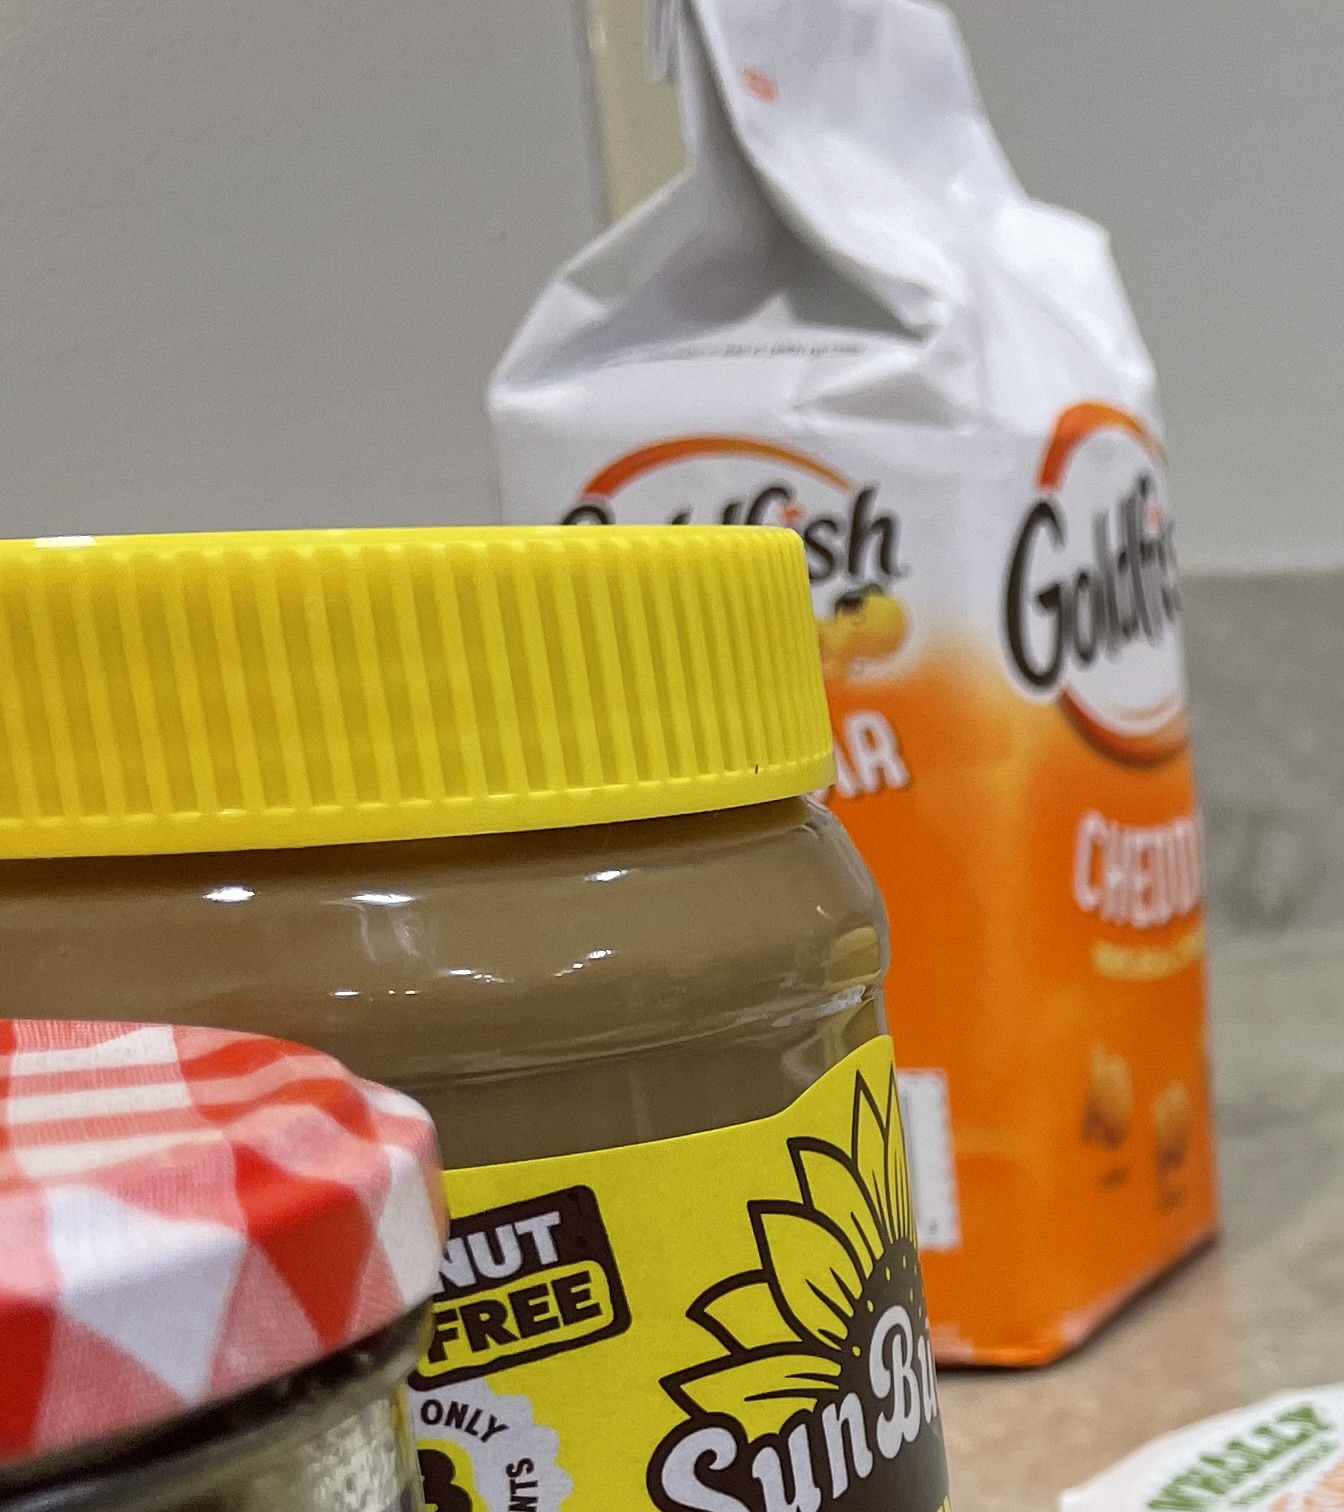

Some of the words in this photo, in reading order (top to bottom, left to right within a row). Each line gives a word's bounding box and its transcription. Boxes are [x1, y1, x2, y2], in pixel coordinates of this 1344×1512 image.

[433, 1211, 562, 1293] NUT
[428, 1270, 603, 1364] FREE
[420, 1398, 510, 1444] ONLY
